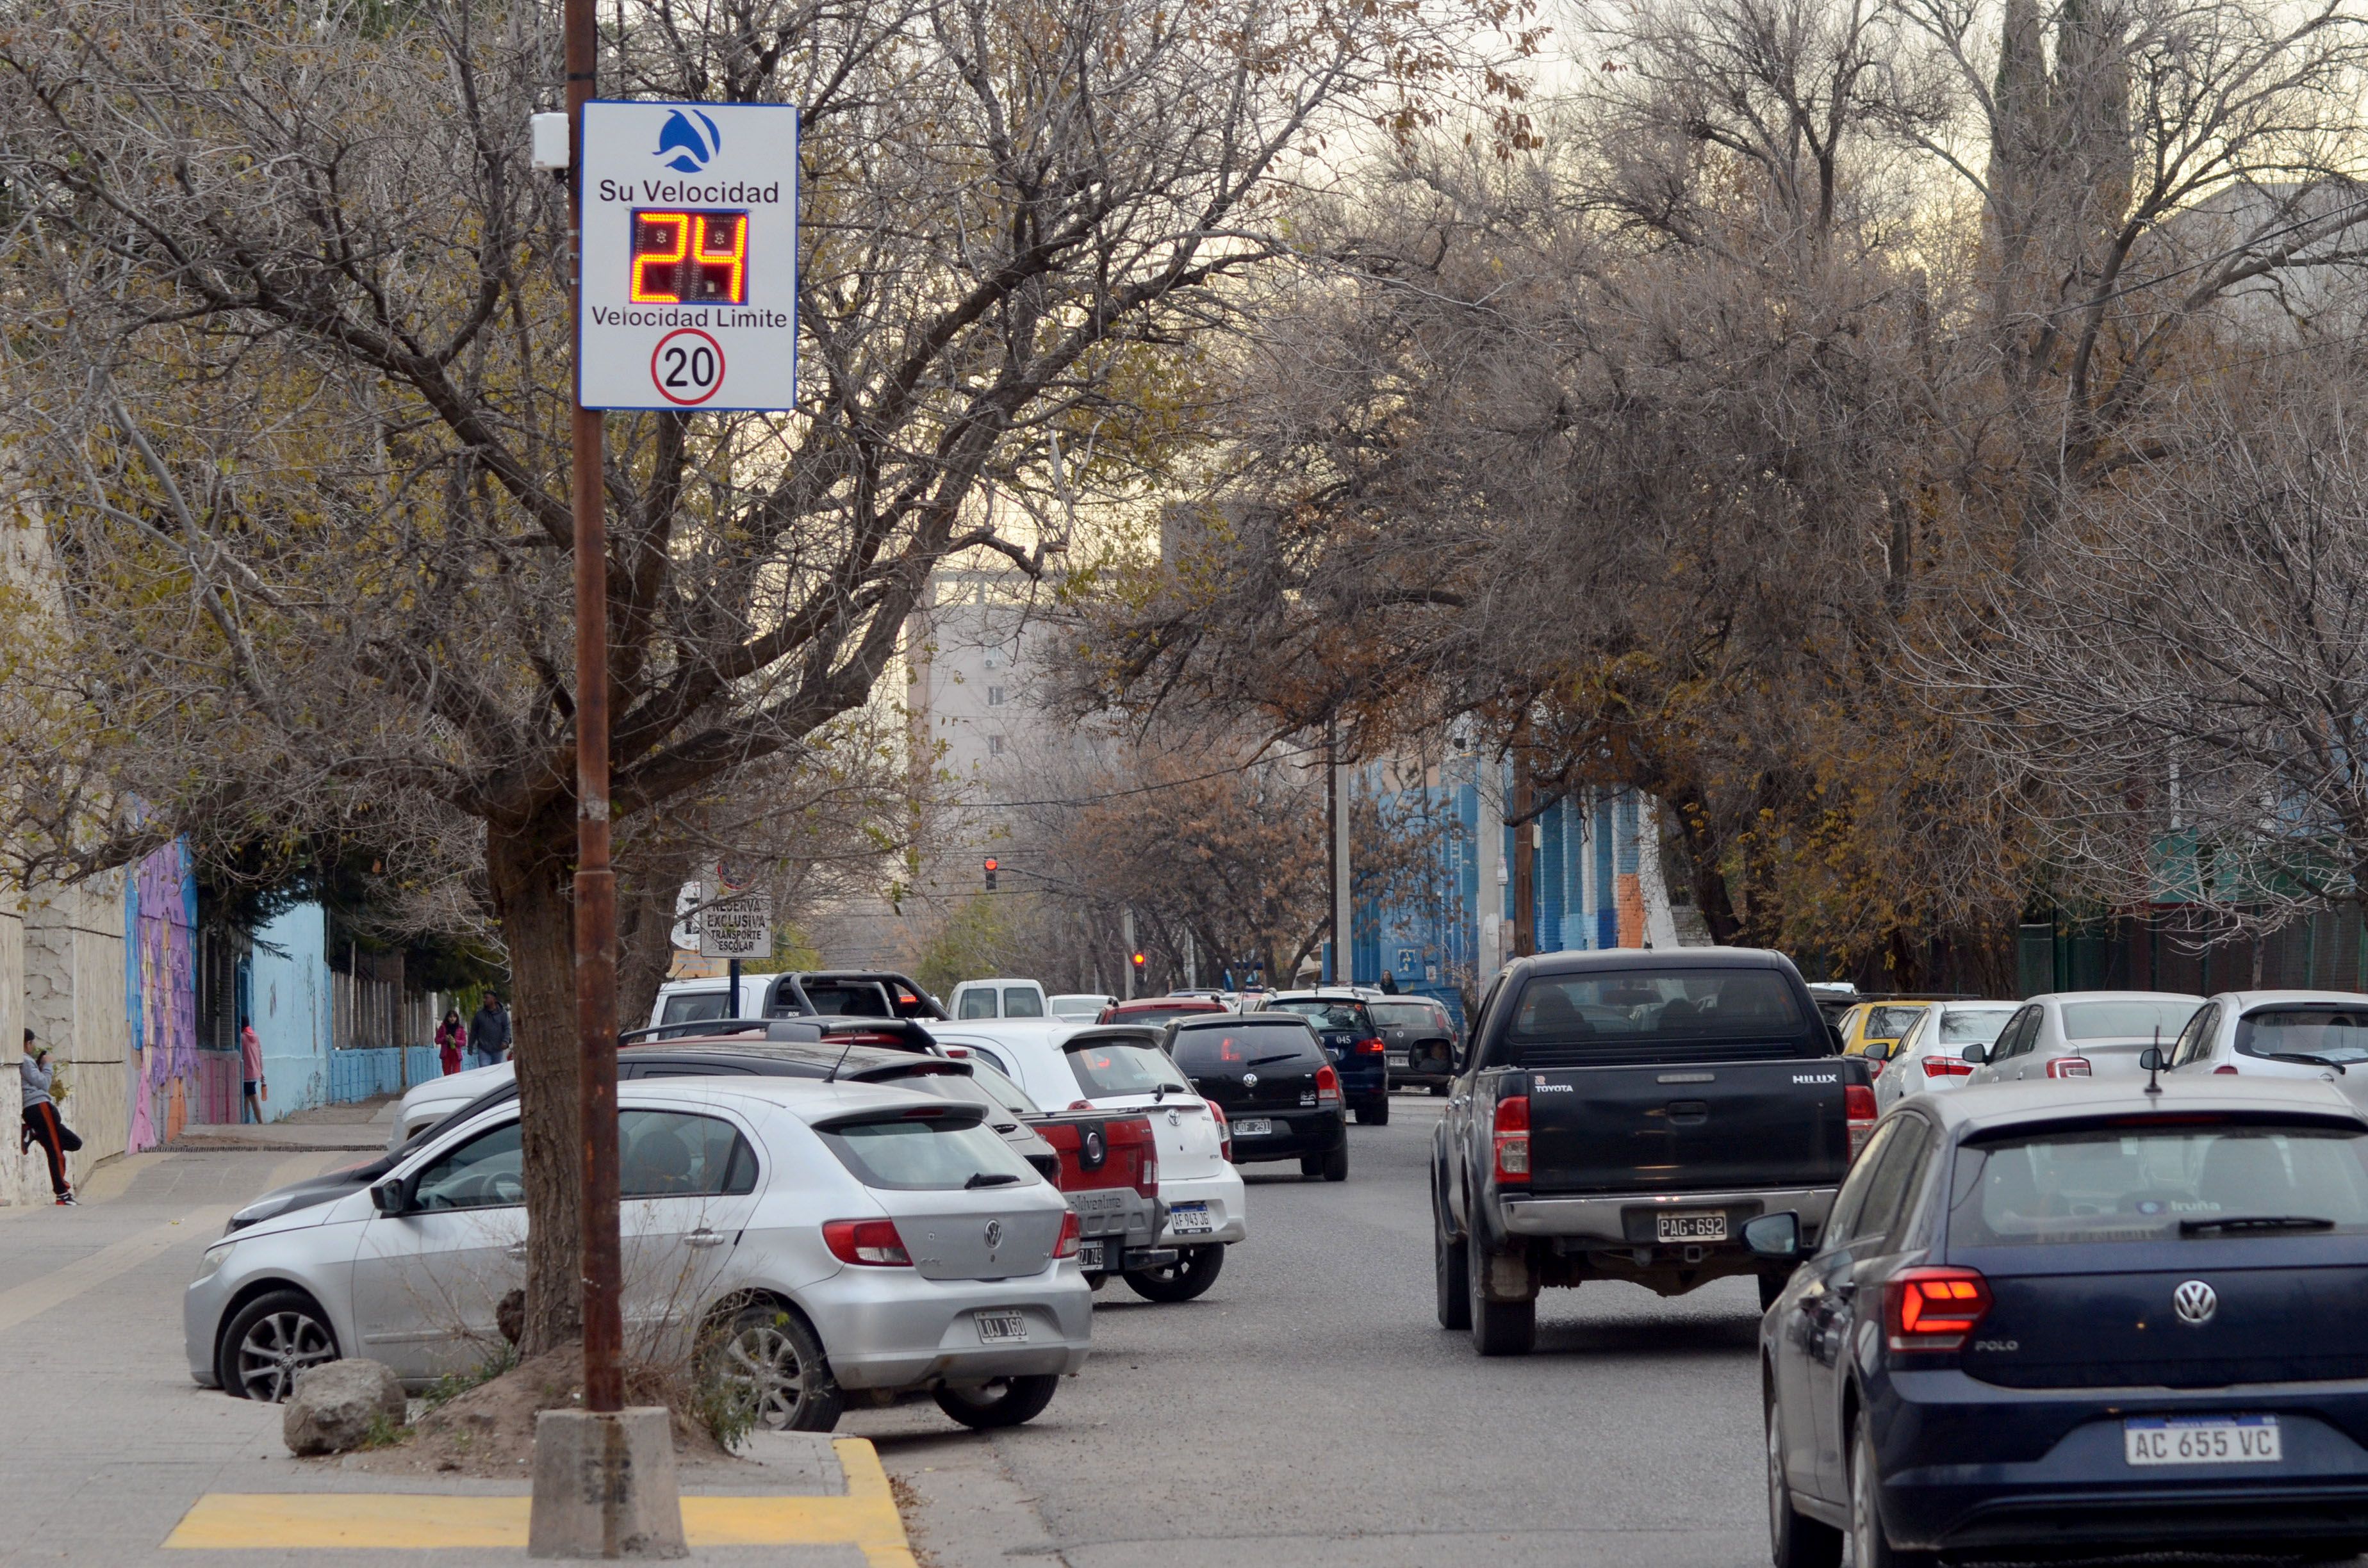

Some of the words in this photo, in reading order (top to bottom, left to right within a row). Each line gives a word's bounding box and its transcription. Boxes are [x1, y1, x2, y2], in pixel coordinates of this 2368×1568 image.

[599, 179, 634, 202] Su
[643, 180, 779, 203] Velocidad
[630, 213, 748, 304] 24
[591, 306, 709, 328] Velocidad
[717, 309, 787, 328] Limite
[664, 347, 715, 387] 20
[707, 915, 765, 927] EXCLUSIVA
[711, 930, 761, 940] TRANSPORTE
[719, 941, 753, 951] ESCOLAR
[1336, 1035, 1351, 1044] 045
[1793, 1074, 1838, 1084] HILUX
[1535, 1084, 1574, 1093] TOYOTA
[1254, 1122, 1269, 1131] 291
[1174, 1214, 1183, 1227] AF
[1660, 1220, 1688, 1236] PAG
[1697, 1218, 1723, 1235] 692
[1090, 1248, 1103, 1264] 749
[1003, 1318, 1026, 1336] 160
[1975, 1340, 2019, 1351] POLO
[2136, 1432, 2167, 1459] AC
[2179, 1430, 2228, 1458] 655
[2239, 1429, 2272, 1456] VC
